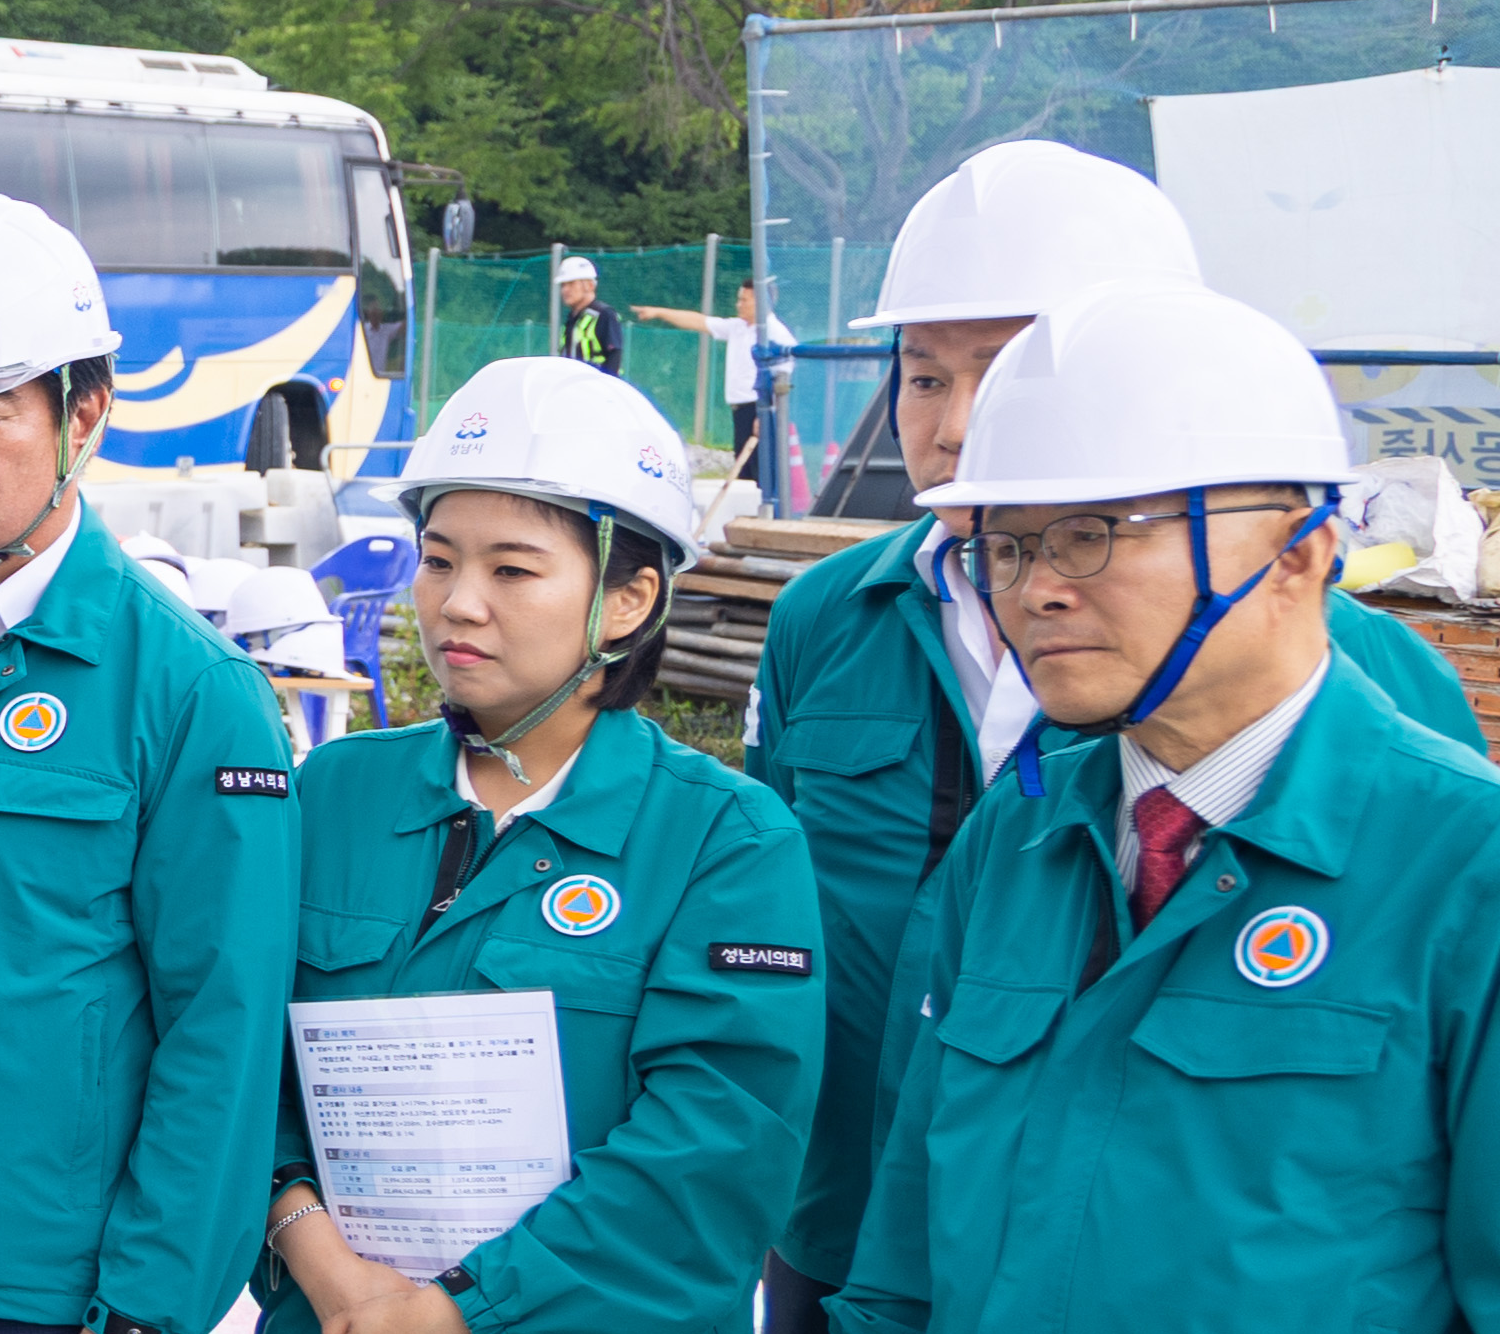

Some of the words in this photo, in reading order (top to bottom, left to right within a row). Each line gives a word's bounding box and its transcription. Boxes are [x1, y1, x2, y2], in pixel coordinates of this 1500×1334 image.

[450, 443, 484, 456] 성남시
[219, 771, 287, 791] 성남시의회
[720, 947, 804, 969] 성남시의회
